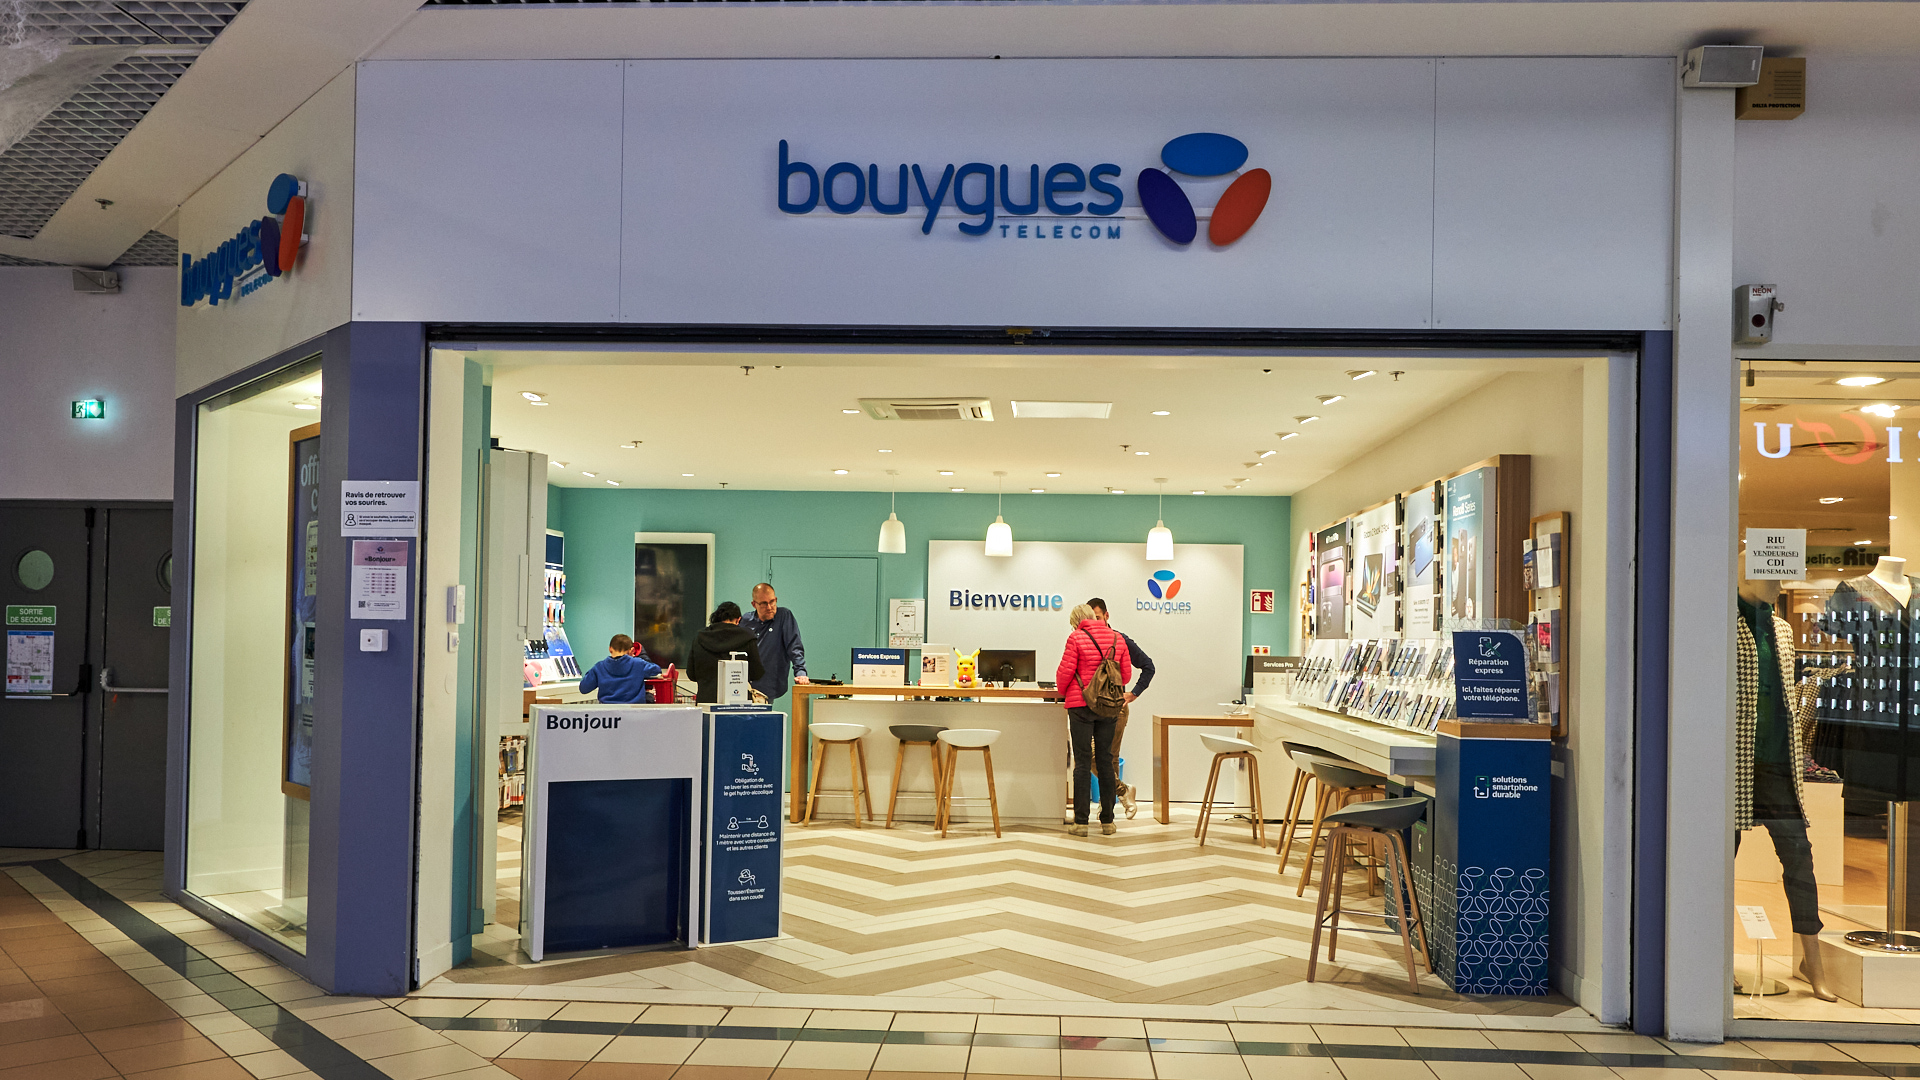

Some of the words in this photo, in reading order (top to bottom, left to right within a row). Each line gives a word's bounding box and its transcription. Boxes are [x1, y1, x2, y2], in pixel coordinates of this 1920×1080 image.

[778, 138, 1124, 236] bouygues
[1000, 224, 1122, 239] TELECOM
[180, 220, 264, 306] bouygues
[1465, 501, 1476, 514] Series
[1844, 548, 1880, 566] Riu
[950, 589, 1063, 608] Bienvenue
[1136, 597, 1191, 614] bouygues
[1468, 658, 1509, 666] Réparation
[546, 714, 622, 733] Bonjour
[1492, 784, 1538, 794] smartphone
